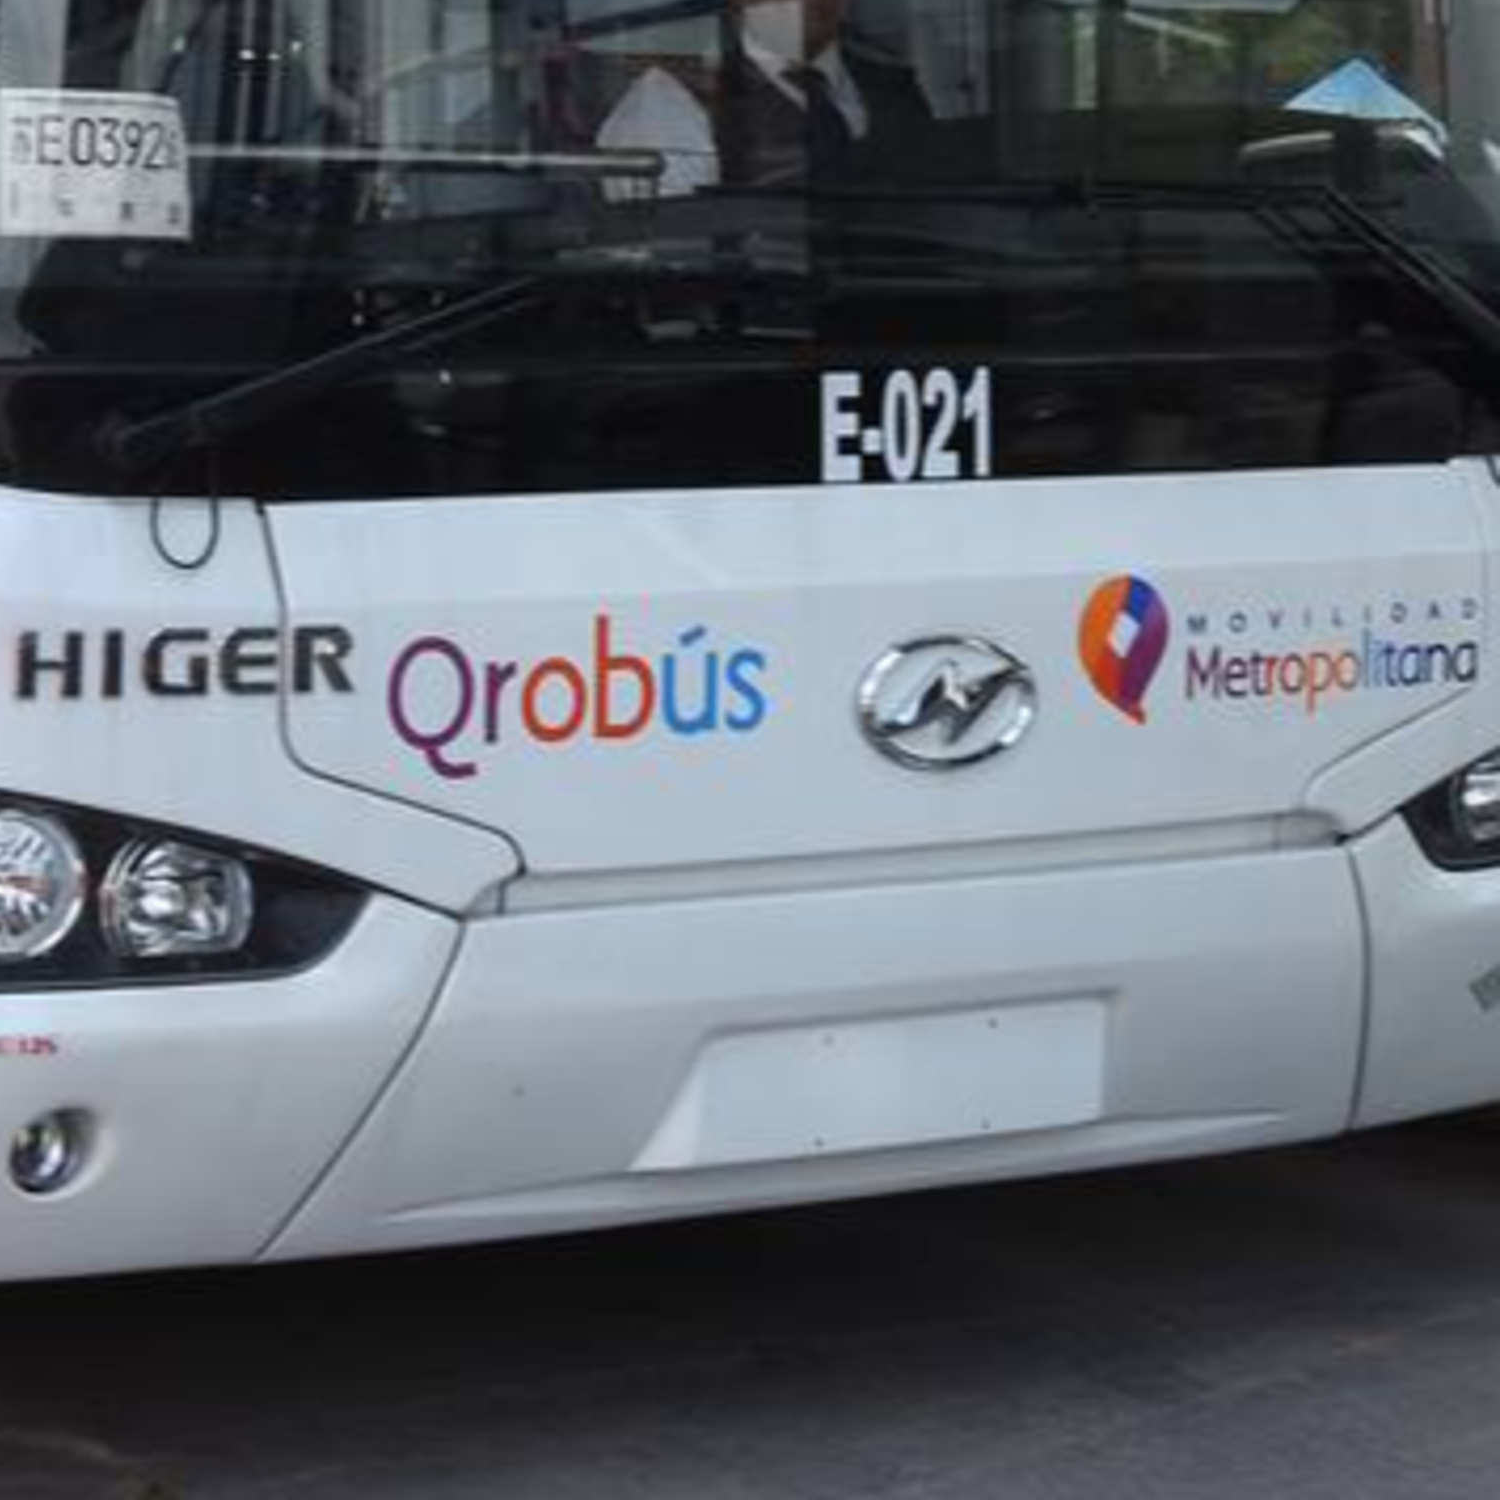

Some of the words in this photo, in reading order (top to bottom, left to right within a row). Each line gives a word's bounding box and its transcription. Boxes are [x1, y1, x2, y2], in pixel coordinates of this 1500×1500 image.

[820, 366, 993, 482] E-021
[1187, 599, 1478, 632] MOVILIDAD
[15, 624, 354, 700] HIGER
[387, 615, 767, 779] Qrobús
[1185, 627, 1478, 716] Metropolitana
